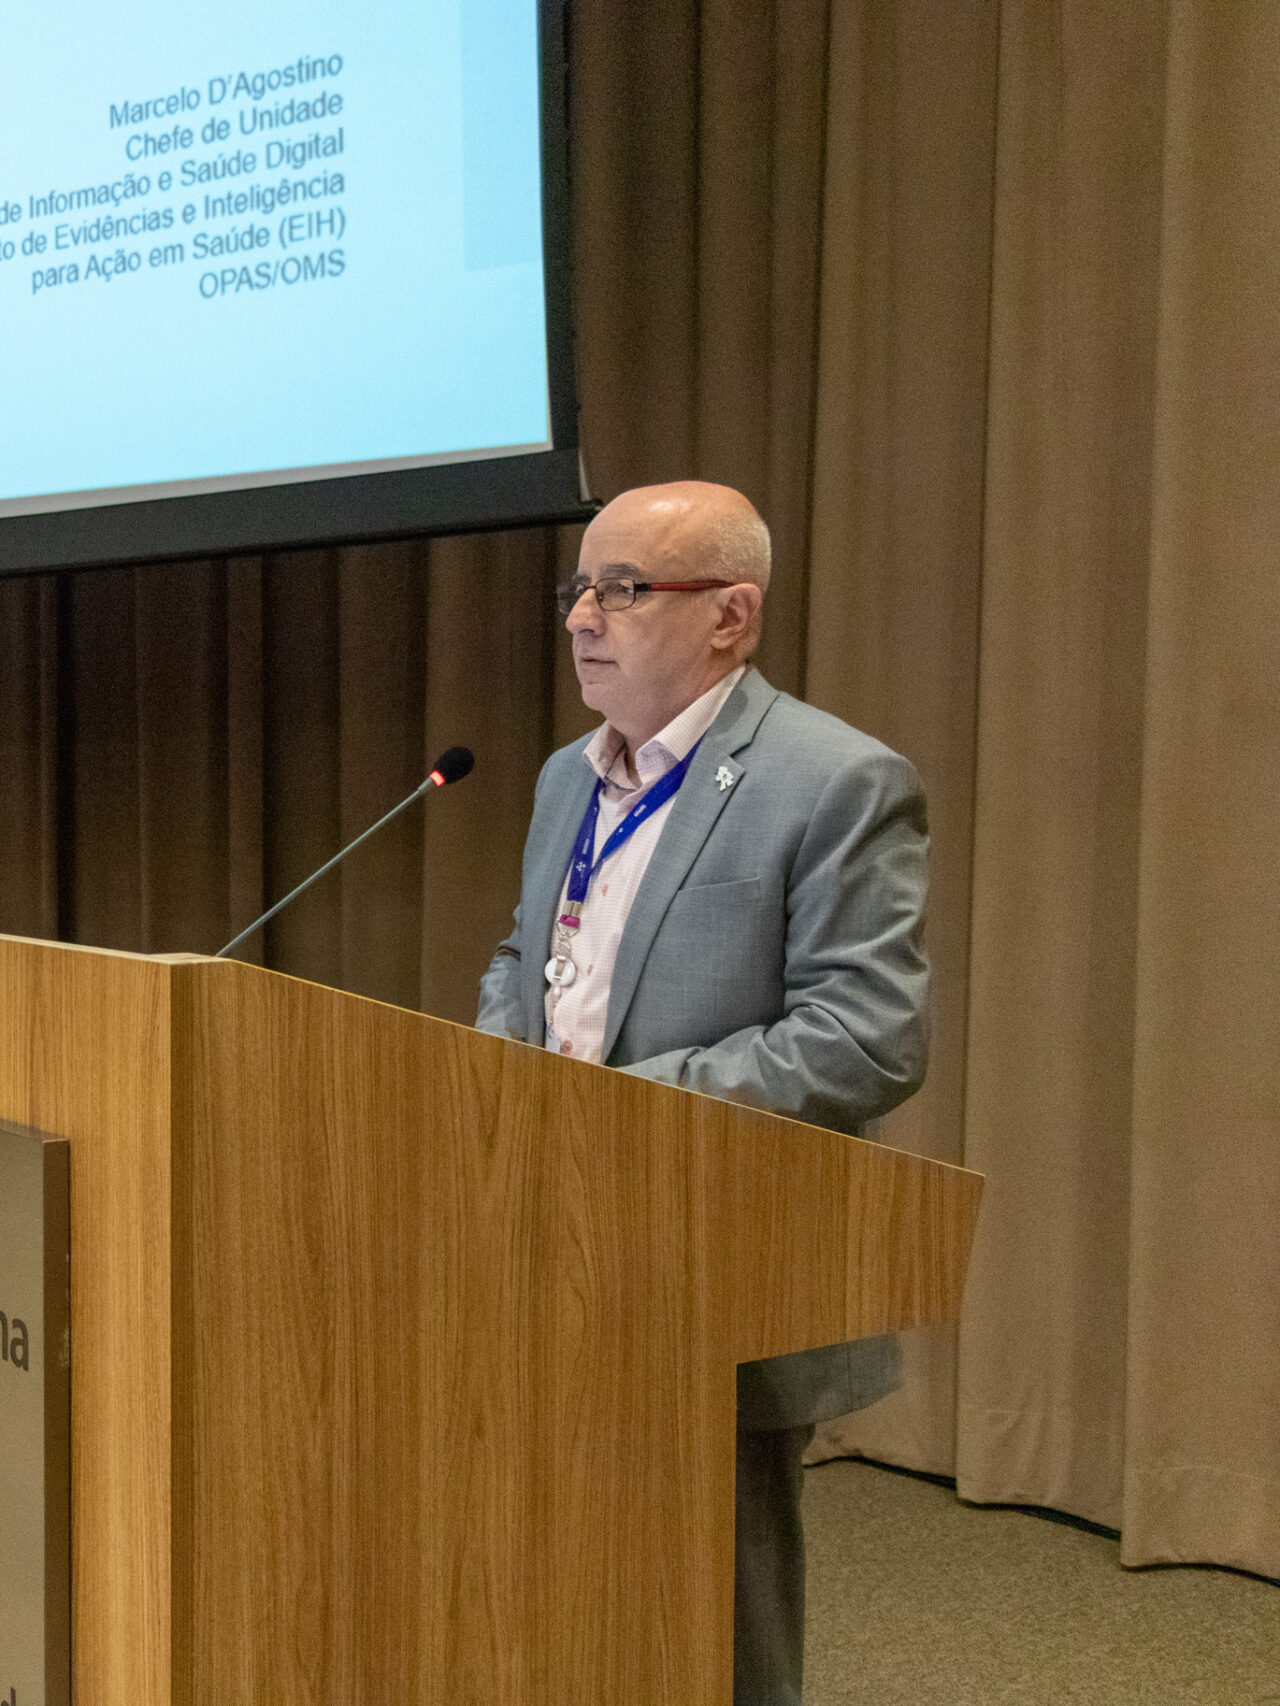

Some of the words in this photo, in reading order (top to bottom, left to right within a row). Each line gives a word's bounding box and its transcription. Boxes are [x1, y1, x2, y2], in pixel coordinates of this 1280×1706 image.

[109, 86, 201, 129] Marcelo
[208, 54, 343, 106] D'Agostino
[125, 124, 194, 161] Chefe
[201, 117, 231, 144] de
[239, 91, 344, 136] Unidade
[22, 231, 48, 256] de
[55, 207, 174, 250] Evidências
[182, 203, 196, 224] e
[204, 170, 345, 220] Inteligência
[29, 172, 151, 219] Informação
[158, 170, 172, 191] e
[180, 149, 257, 187] Saúde
[266, 127, 344, 170] Digital
[32, 261, 80, 294] para
[84, 249, 142, 282] Ação
[149, 242, 185, 268] em
[192, 223, 270, 260] Saúde
[279, 206, 346, 250] (EIH)
[199, 248, 346, 299] OPAS/OMS
